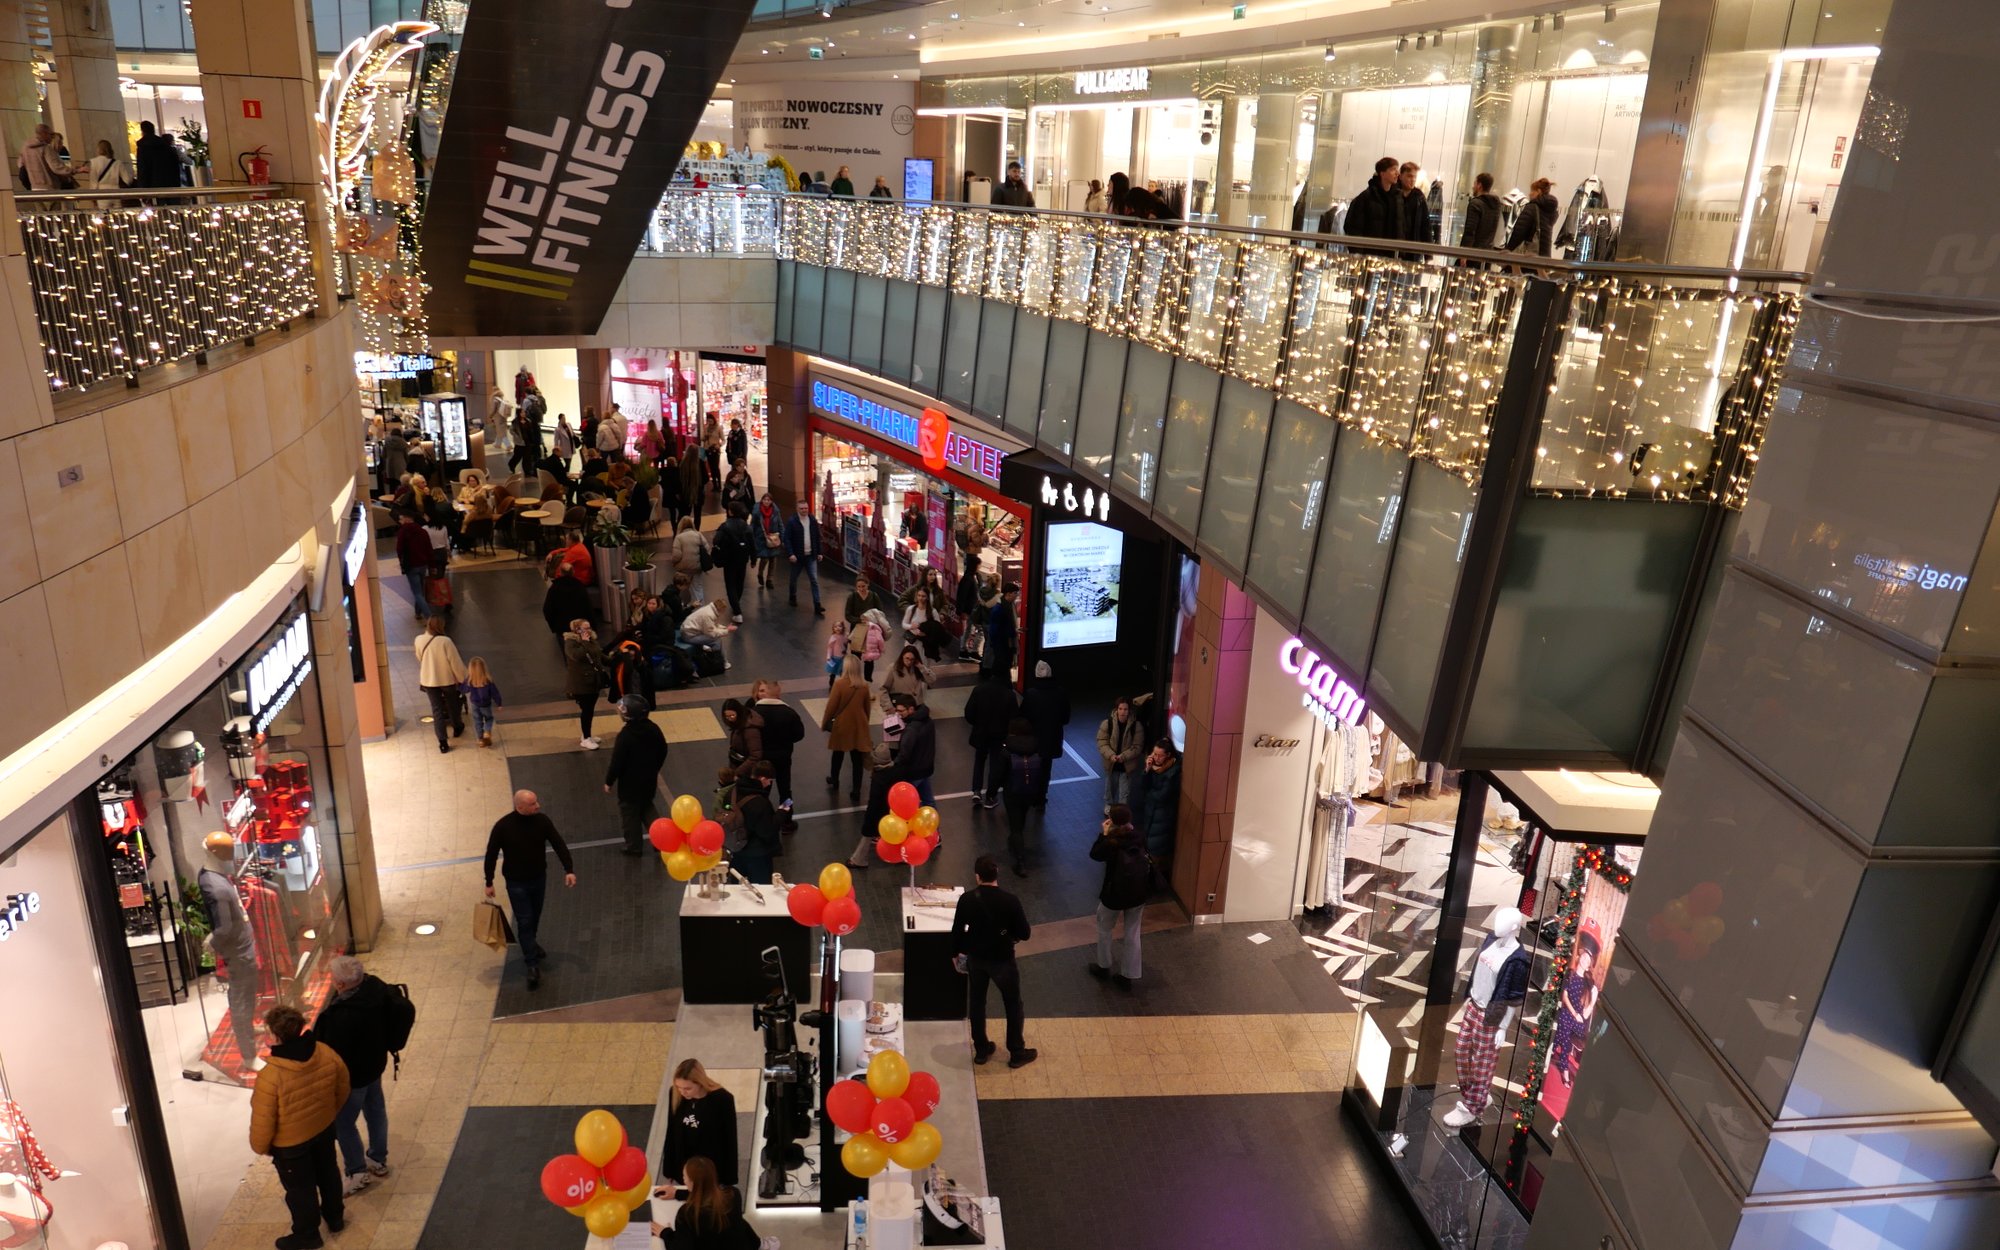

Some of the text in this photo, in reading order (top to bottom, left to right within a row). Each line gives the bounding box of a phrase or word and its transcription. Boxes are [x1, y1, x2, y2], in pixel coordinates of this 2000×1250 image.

[1075, 66, 1149, 94] PULL&BEAR
[786, 99, 884, 116] NOWOCZESNY
[531, 42, 666, 273] FITNESS
[472, 116, 570, 255] WELL
[812, 380, 1010, 482] SUPER-PHARM APTEK
[1302, 691, 1338, 732] PARIS
[878, 1122, 898, 1144] %
[566, 1177, 595, 1200] %
